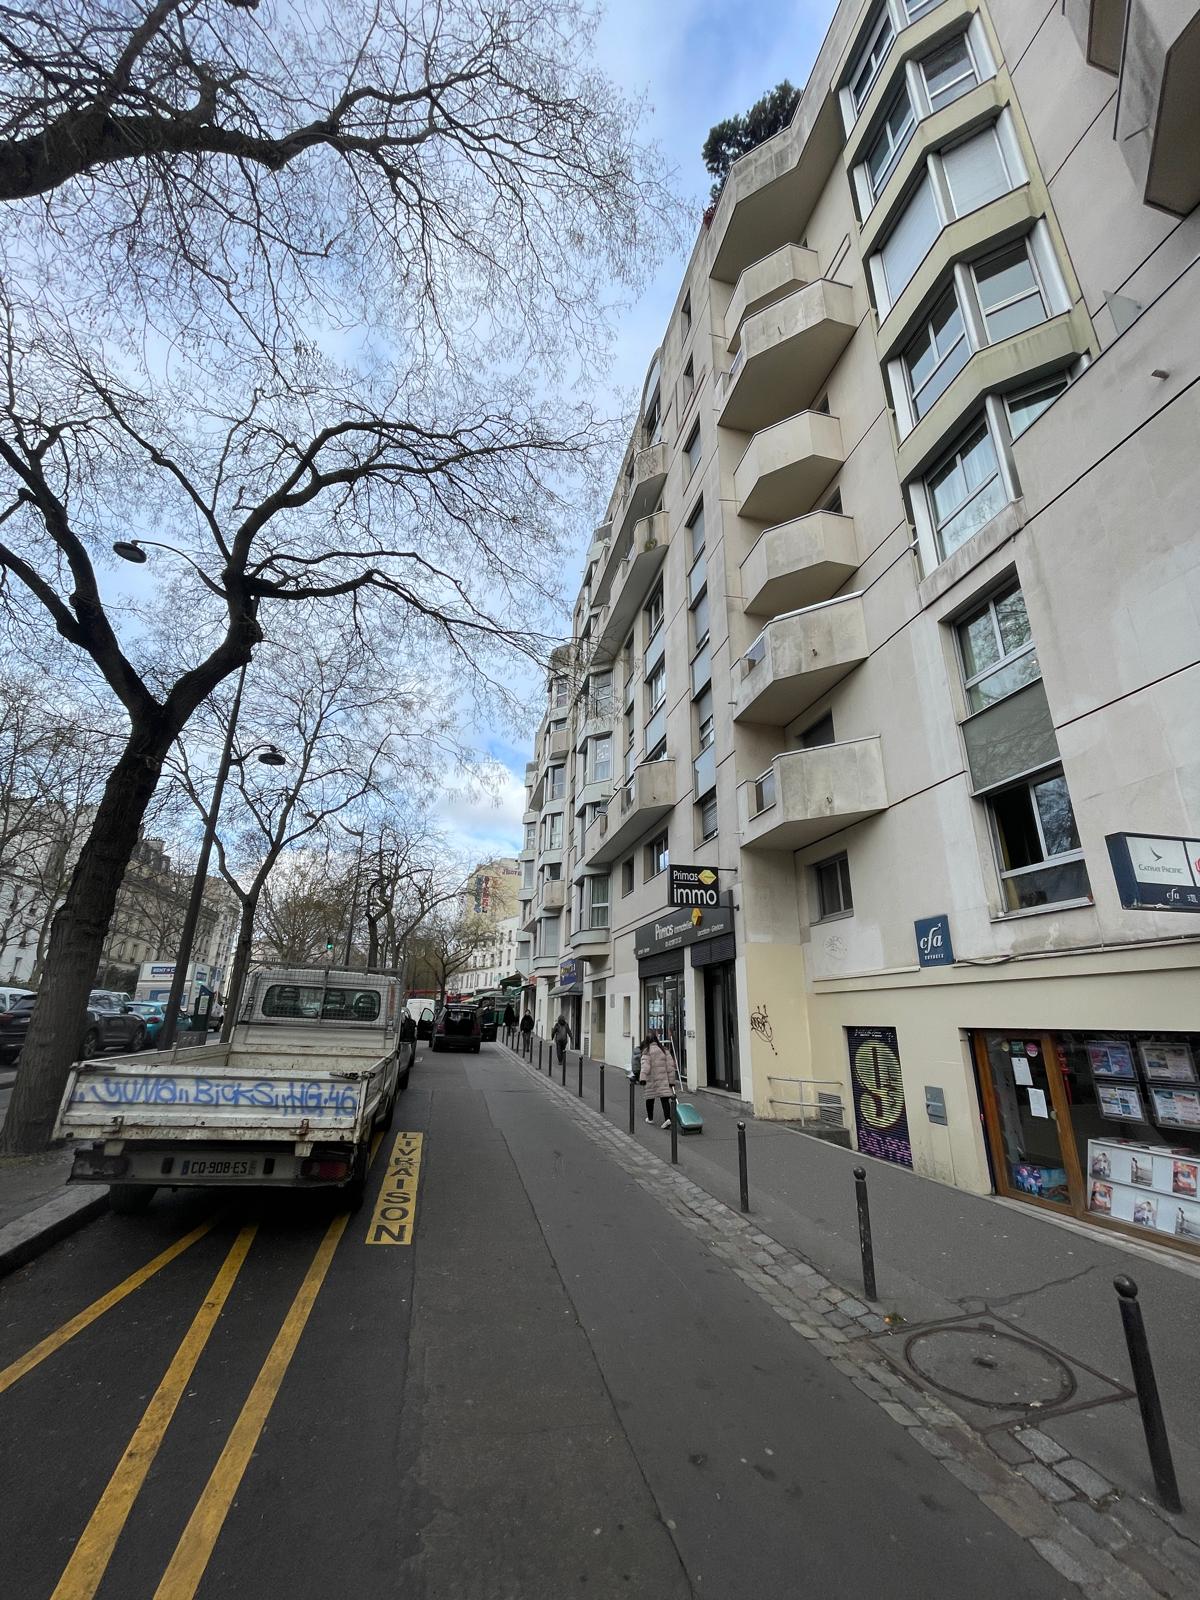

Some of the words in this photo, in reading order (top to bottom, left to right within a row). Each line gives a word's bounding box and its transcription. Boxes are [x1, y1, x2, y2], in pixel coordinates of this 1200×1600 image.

[673, 870, 698, 881] Primas
[673, 884, 717, 905] immo
[919, 922, 943, 954] cfa
[373, 1133, 417, 1242] LIVRAISON
